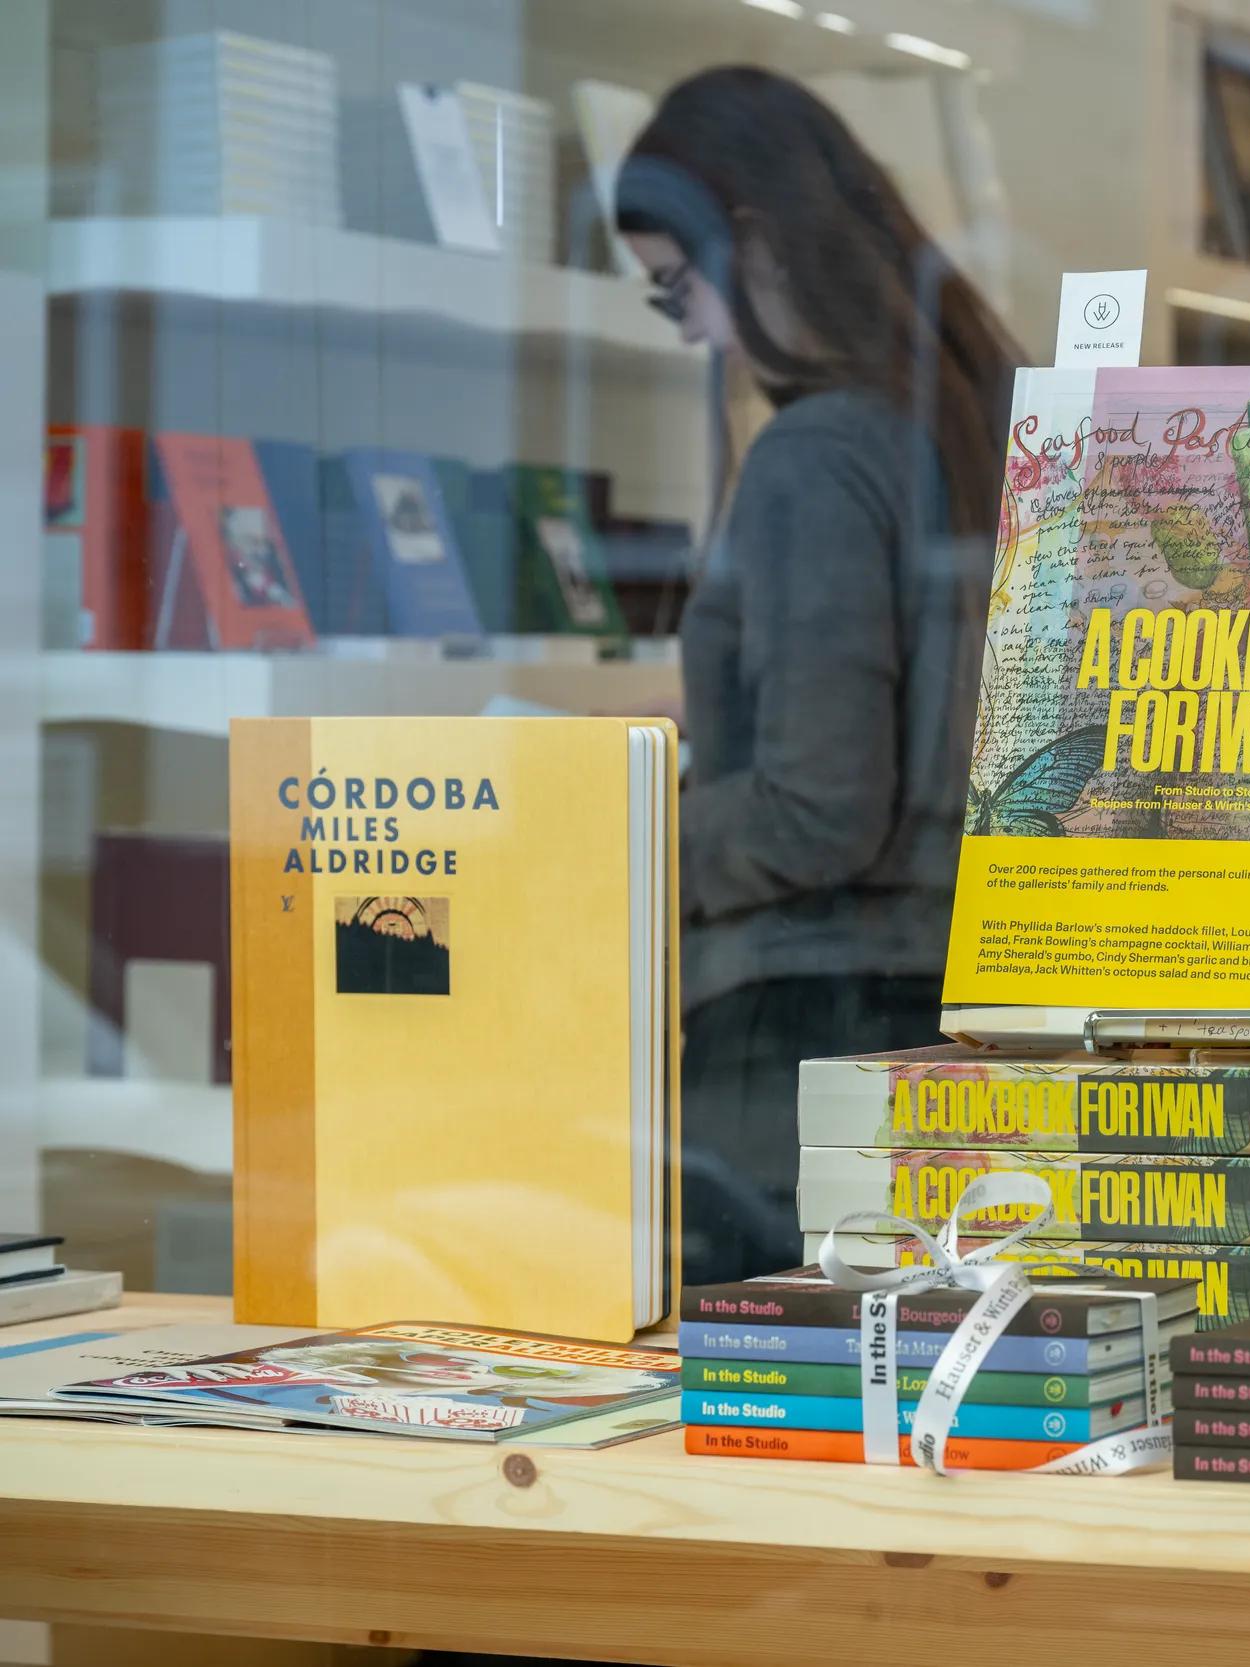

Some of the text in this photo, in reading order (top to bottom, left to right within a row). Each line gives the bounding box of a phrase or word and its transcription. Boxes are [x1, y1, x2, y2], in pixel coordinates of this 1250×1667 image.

[1013, 411, 1149, 491] Seafood
[1110, 441, 1160, 483] people
[1076, 608, 1112, 690] A
[1102, 690, 1200, 773] FOR
[278, 767, 500, 811] CÓRDOBA
[1154, 785, 1182, 797] From
[1183, 785, 1220, 797] Studio
[1222, 787, 1234, 797] to
[1090, 798, 1133, 811] Recipes
[1134, 798, 1161, 811] from
[1163, 799, 1203, 811] Hauser
[1205, 800, 1213, 811] &
[300, 816, 400, 842] MILES
[283, 848, 457, 876] ALDRIDGE
[988, 863, 1015, 874] Over
[1016, 864, 1037, 875] 200
[1038, 865, 1078, 877] recipes
[1080, 866, 1129, 878] gathered
[1131, 866, 1157, 877] from
[1159, 868, 1176, 878] the
[1178, 869, 1226, 881] personal
[987, 878, 1169, 892] of the gallerists' family and friends.
[982, 920, 1007, 930] With
[1009, 920, 1053, 933] Phyllida
[1055, 921, 1102, 932] Barlow's
[1105, 923, 1149, 934] smoked
[1151, 925, 1199, 936] haddock
[1201, 926, 1229, 937] fillet,
[980, 934, 1011, 946] salad,
[1013, 935, 1043, 945] Frank
[1045, 936, 1097, 948] Bowling's
[1098, 937, 1162, 950] champagne
[1165, 940, 1210, 951] cocktail,
[978, 948, 1002, 961] Amy
[1003, 949, 1052, 960] Sherald's
[1054, 951, 1095, 962] gumbo,
[1096, 952, 1127, 964] Cindy
[1128, 953, 1185, 964] Sherman's
[1187, 955, 1217, 966] garlic
[1219, 956, 1240, 966] and
[976, 963, 1033, 975] jambalaya,
[1034, 964, 1058, 974] Jack
[1060, 965, 1111, 976] Whitten's
[1113, 967, 1157, 979] octopus
[1159, 968, 1188, 979] salad
[1190, 970, 1211, 980] and
[1213, 972, 1227, 980] so
[893, 1079, 1224, 1138] A COOKBOOK FOR IWAN
[893, 1167, 914, 1220] A
[1082, 1170, 1141, 1226] FOR
[1144, 1172, 1226, 1228] IWAN
[700, 1299, 785, 1316] In the Studio
[371, 1330, 680, 1367] PAPER ALDRIDGE
[424, 1329, 666, 1361] TOILET MILES
[869, 1322, 887, 1359] the
[1190, 1347, 1209, 1364] In
[1209, 1347, 1232, 1365] the
[703, 1368, 787, 1385] In the Studio
[870, 1365, 887, 1385] In
[1194, 1383, 1212, 1399] In
[1213, 1384, 1236, 1400] the
[702, 1401, 786, 1419] In the Studio
[1194, 1456, 1212, 1472] In
[1213, 1457, 1236, 1473] the
